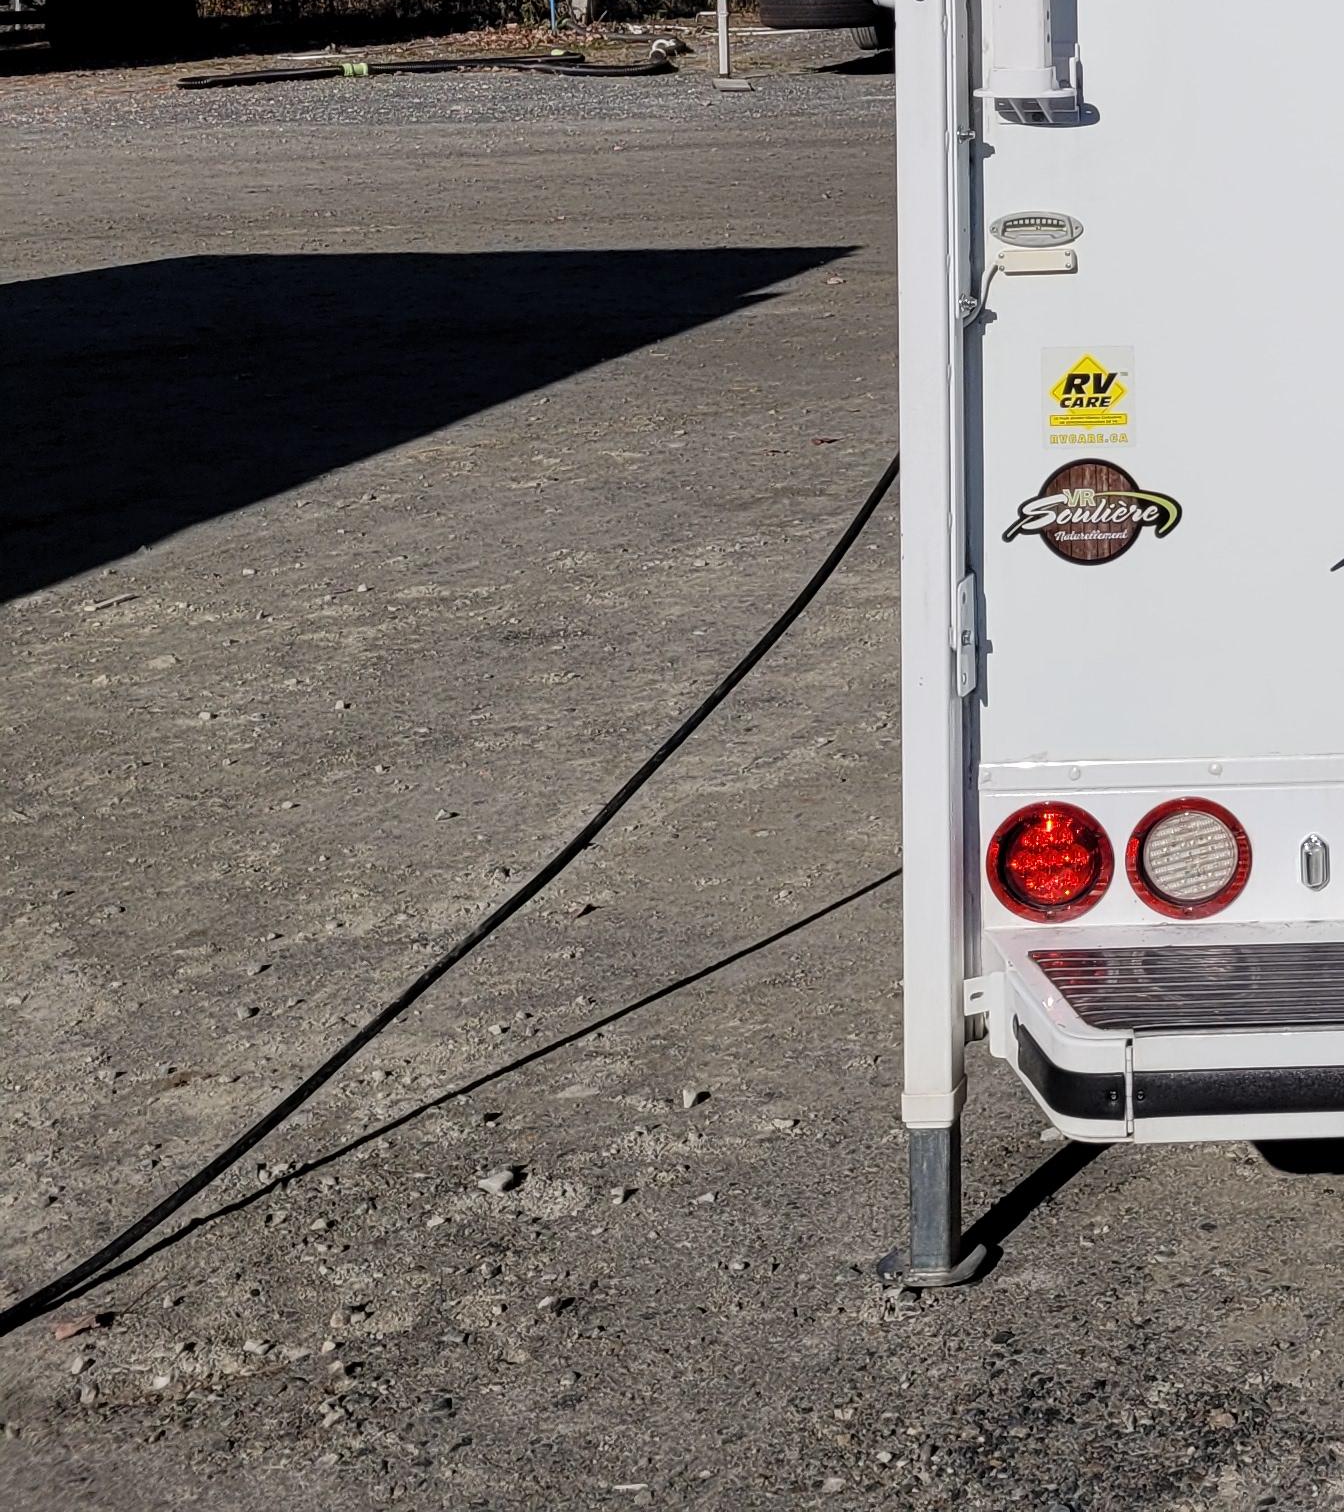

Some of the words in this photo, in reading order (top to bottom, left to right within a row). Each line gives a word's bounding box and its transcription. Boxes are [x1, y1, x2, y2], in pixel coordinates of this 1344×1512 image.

[1062, 372, 1118, 395] RV
[1060, 396, 1112, 408] CARE
[1050, 432, 1129, 445] RVCARE.CA
[1063, 488, 1096, 507] VR
[1006, 492, 1161, 538] Soulière
[1054, 529, 1129, 541] Naturellement
